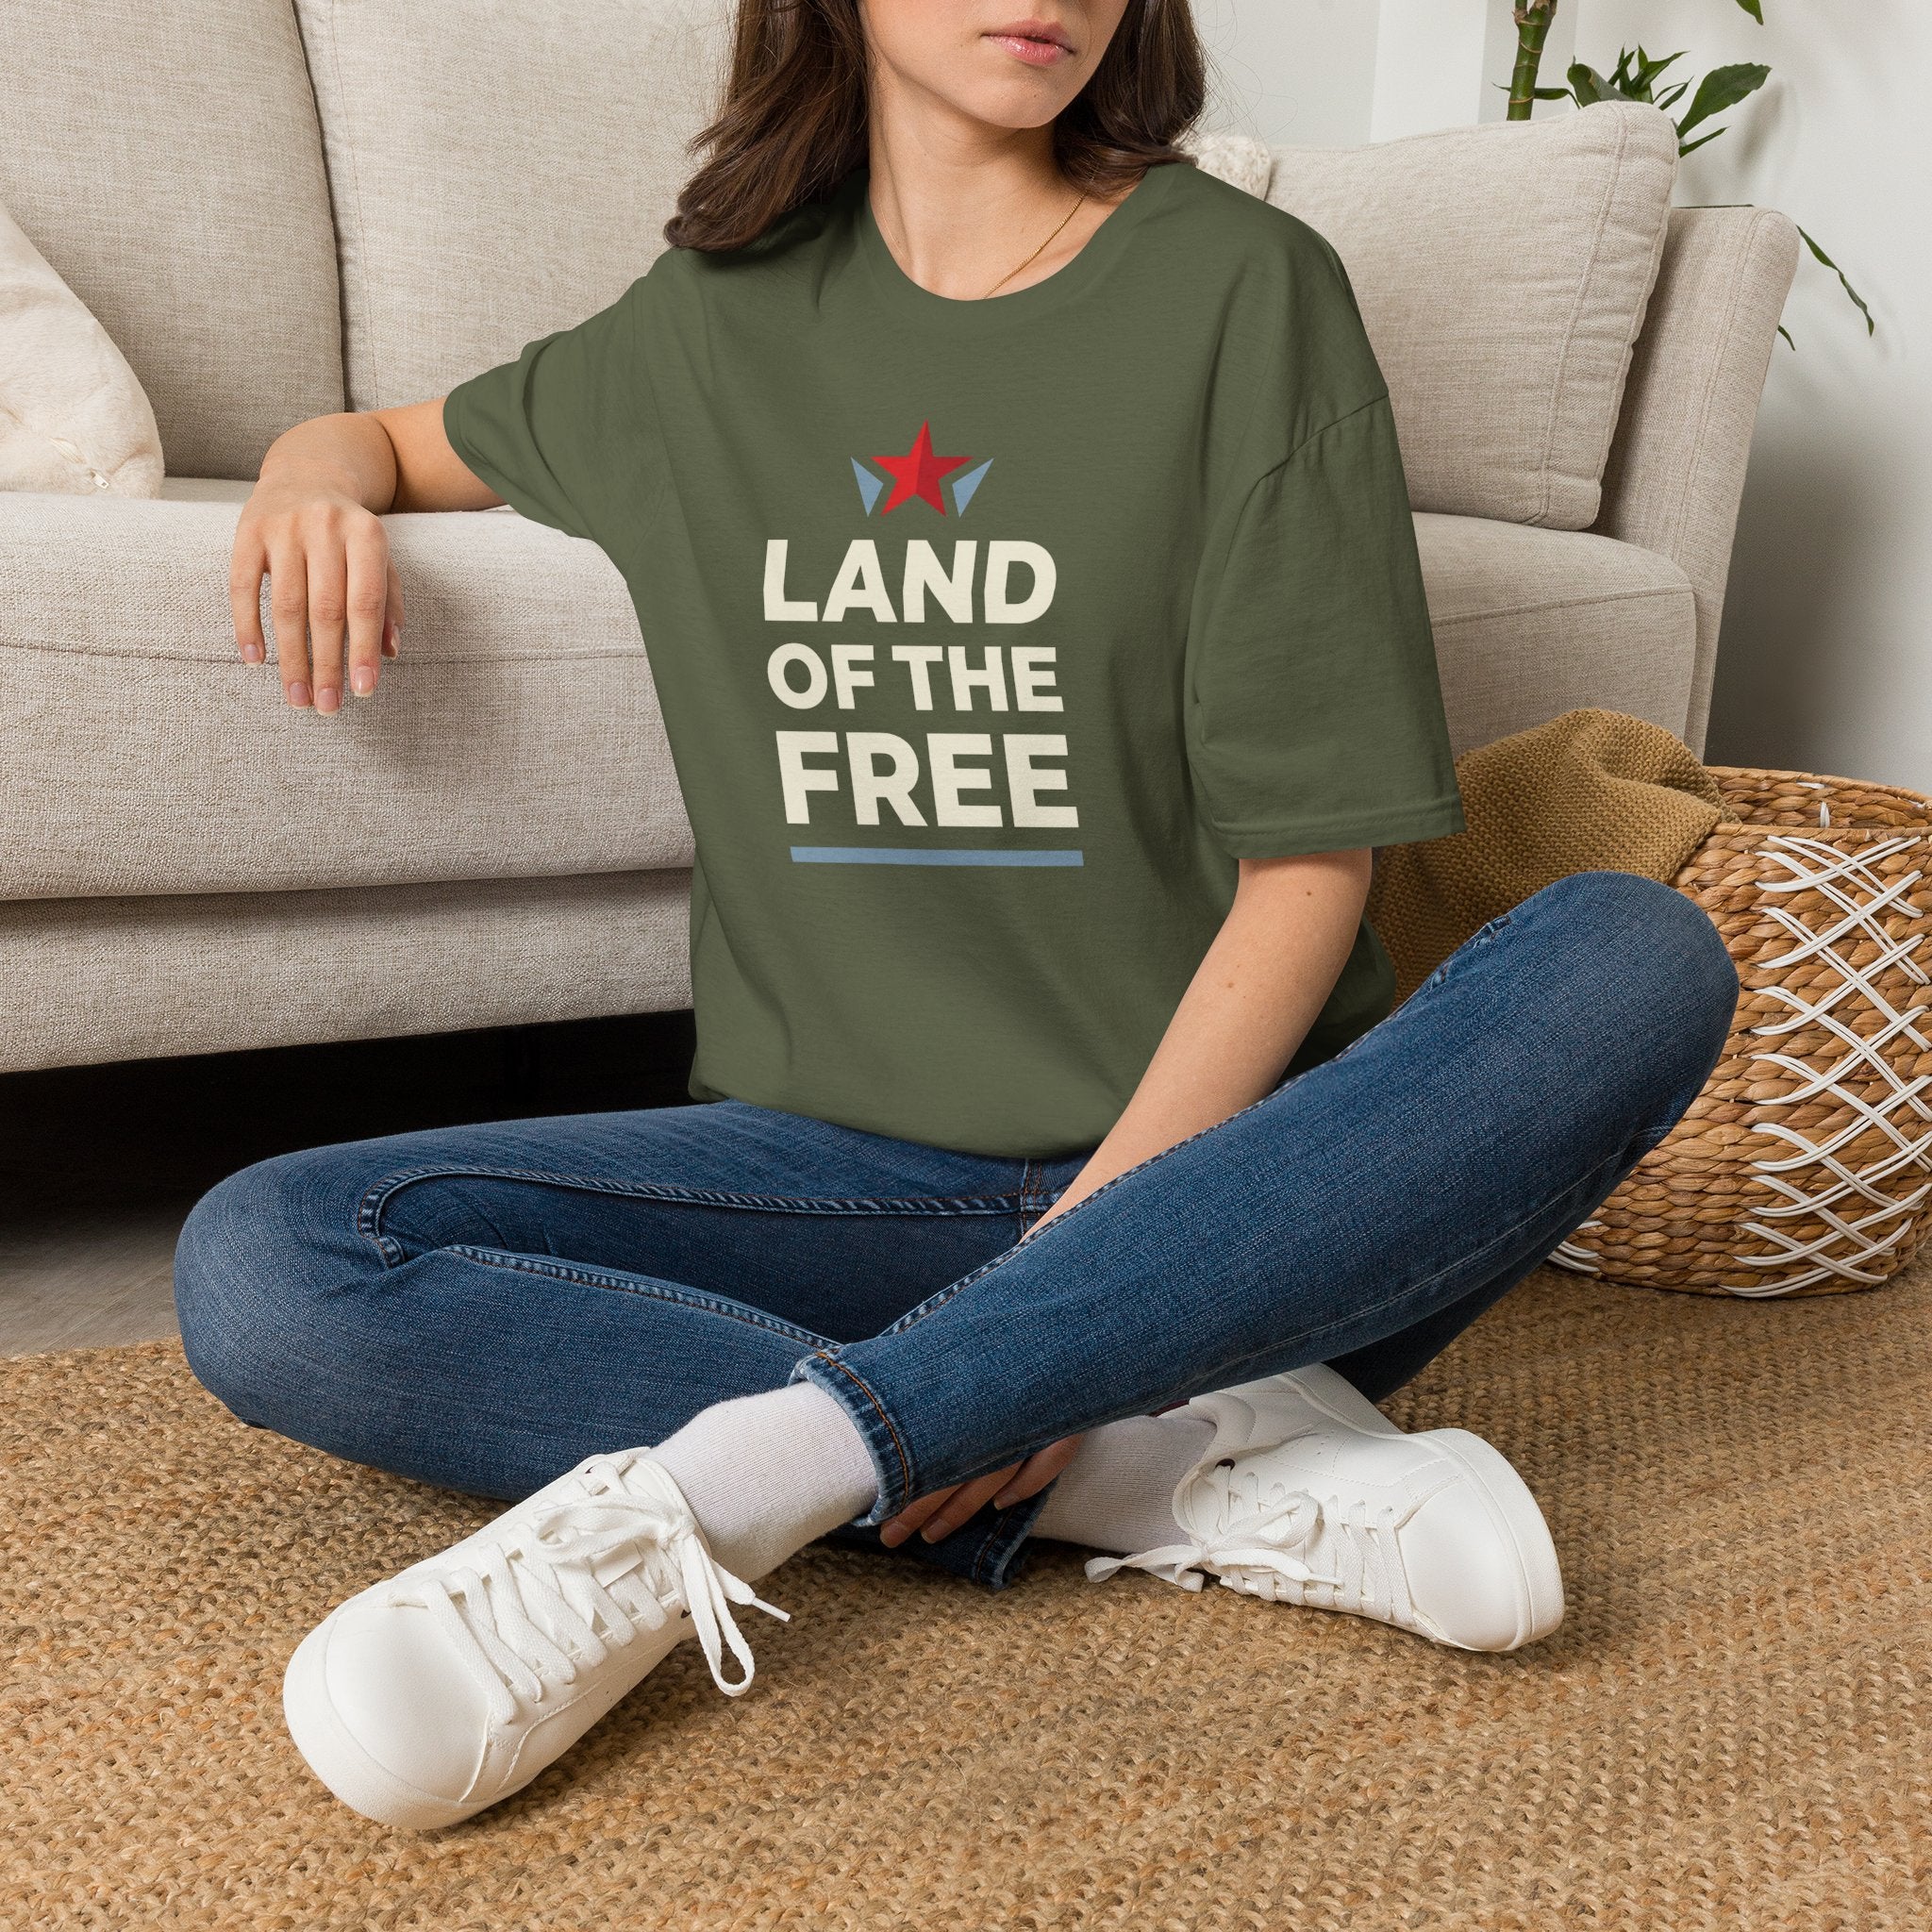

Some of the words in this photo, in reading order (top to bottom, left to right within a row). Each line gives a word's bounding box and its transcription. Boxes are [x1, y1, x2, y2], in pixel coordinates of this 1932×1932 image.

[763, 539, 1057, 625] LAND
[767, 642, 875, 709] OF
[891, 645, 1064, 712] THE
[775, 730, 1079, 828] FREE
